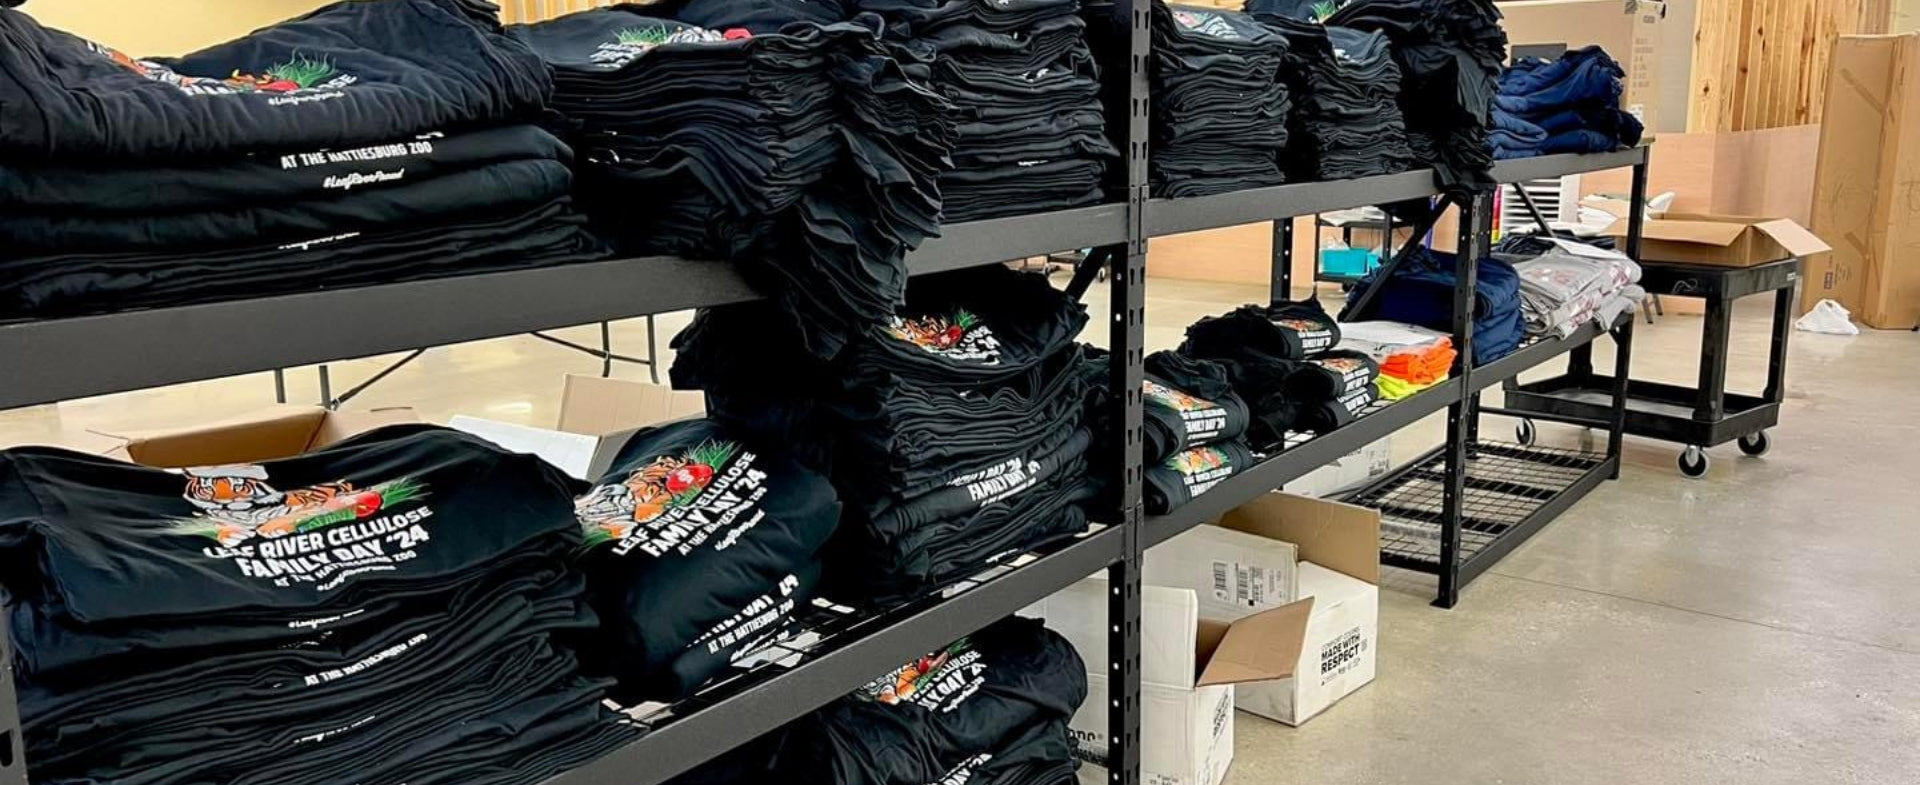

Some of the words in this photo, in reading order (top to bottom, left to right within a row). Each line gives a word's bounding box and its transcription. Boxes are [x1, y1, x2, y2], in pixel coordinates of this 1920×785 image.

[281, 156, 298, 169] AT
[300, 154, 327, 166] THE
[408, 140, 433, 154] ZOO
[967, 476, 1008, 501] FAMILY
[259, 534, 325, 559] RIVER
[328, 506, 434, 546] CELLULOSE
[612, 528, 650, 556] LEAF
[678, 543, 693, 556] AT
[688, 530, 709, 546] THE
[236, 552, 331, 578] FAMILY
[332, 540, 384, 561] DAY
[708, 640, 720, 654] AT
[718, 632, 736, 648] THE
[1321, 642, 1342, 660] MADE
[1342, 633, 1360, 649] WITH
[1321, 643, 1360, 675] RESPECT
[937, 669, 966, 696] DAY
